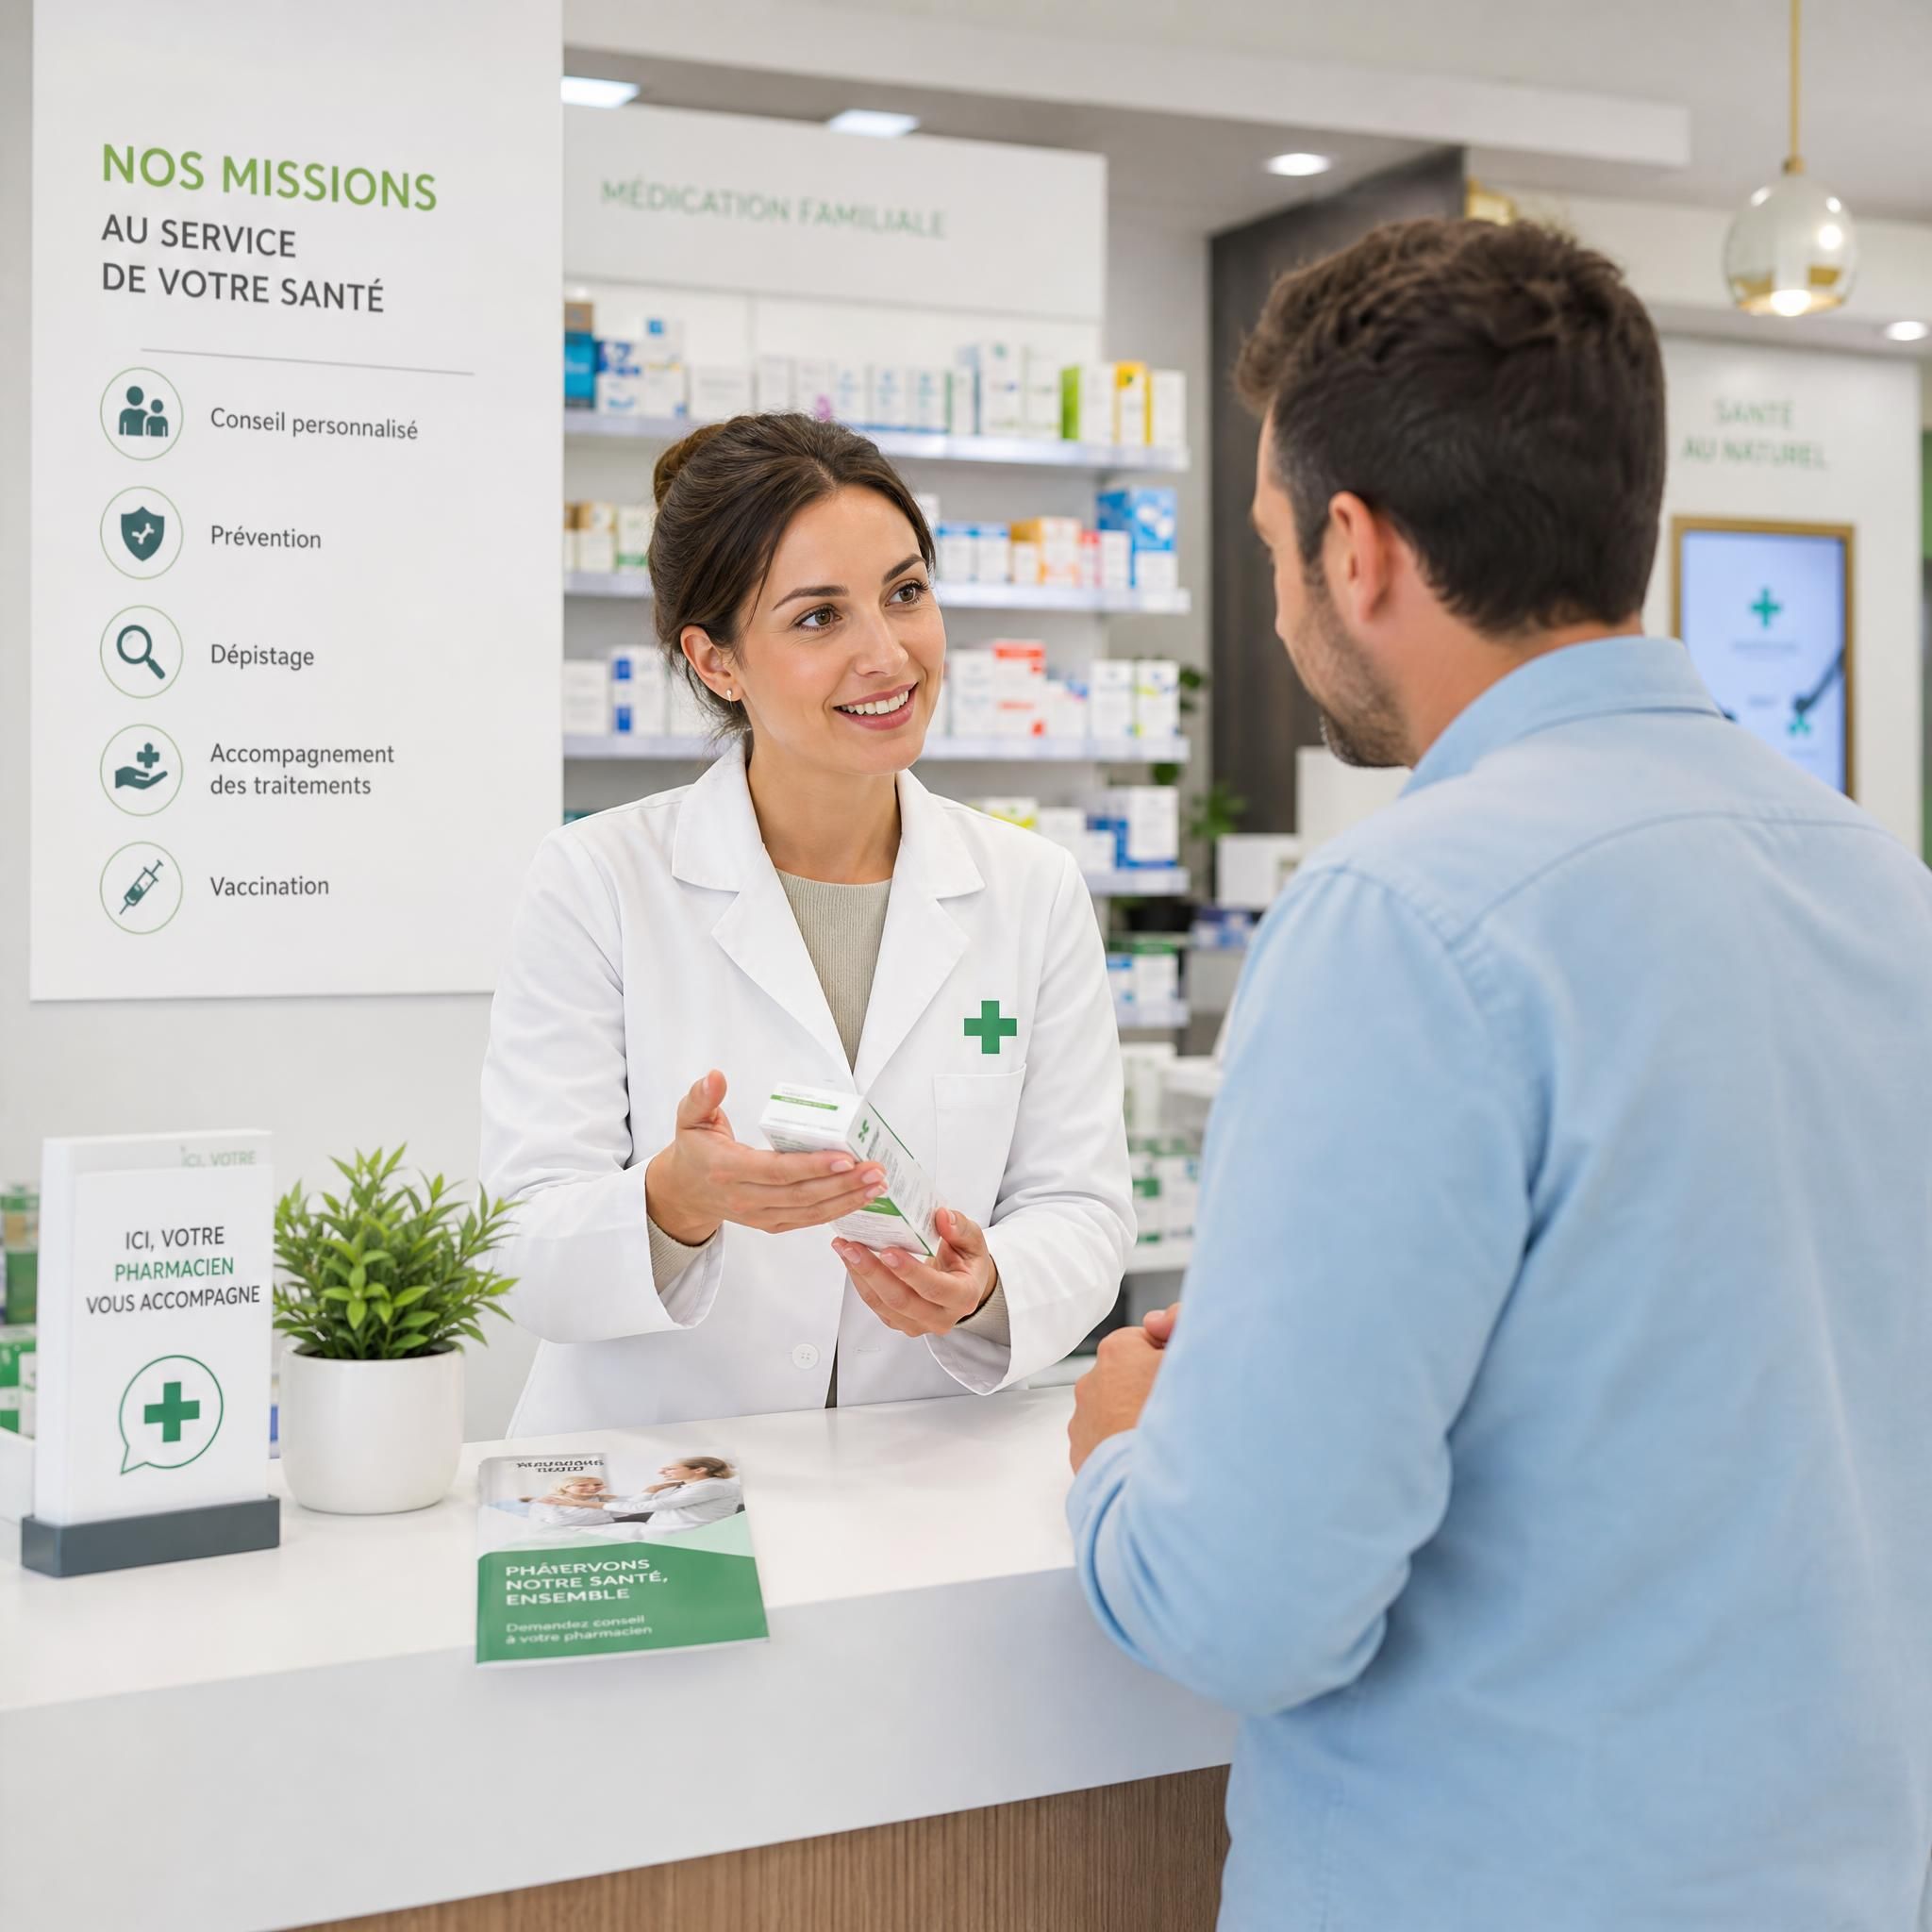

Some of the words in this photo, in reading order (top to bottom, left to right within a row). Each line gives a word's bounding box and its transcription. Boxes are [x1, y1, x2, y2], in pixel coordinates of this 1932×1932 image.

[103, 143, 205, 192] NOS
[223, 156, 438, 211] MISSIONS
[601, 174, 790, 225] MÉDICATION
[798, 196, 947, 241] FAMILIALE
[101, 214, 148, 244] AU
[160, 219, 296, 258] SERVICE
[102, 262, 146, 293] DE
[158, 268, 269, 304] VOTRE
[280, 278, 384, 313] SANTÉ
[210, 408, 286, 432] Conseil
[292, 417, 419, 440] personnalisé
[210, 525, 322, 549] Prévention
[210, 643, 315, 672] Dépistage
[210, 742, 395, 768] Accompagnement
[210, 774, 247, 795] des
[254, 774, 372, 795] traitements
[210, 875, 329, 897] Vaccination
[125, 1230, 155, 1252] ICI,
[161, 1225, 225, 1248] VOTRE
[114, 1257, 234, 1282] PHARMACIEN
[86, 1293, 136, 1315] VOUS
[140, 1285, 261, 1311] ACCOMPAGNE
[506, 1577, 583, 1591] NOTRE
[589, 1571, 669, 1587] SANTÉ,
[506, 1589, 630, 1606] ENSEMBLE
[506, 1620, 590, 1633] Demandez
[592, 1614, 645, 1627] conseil
[520, 1633, 559, 1643] votre
[564, 1625, 653, 1642] pharmacien
